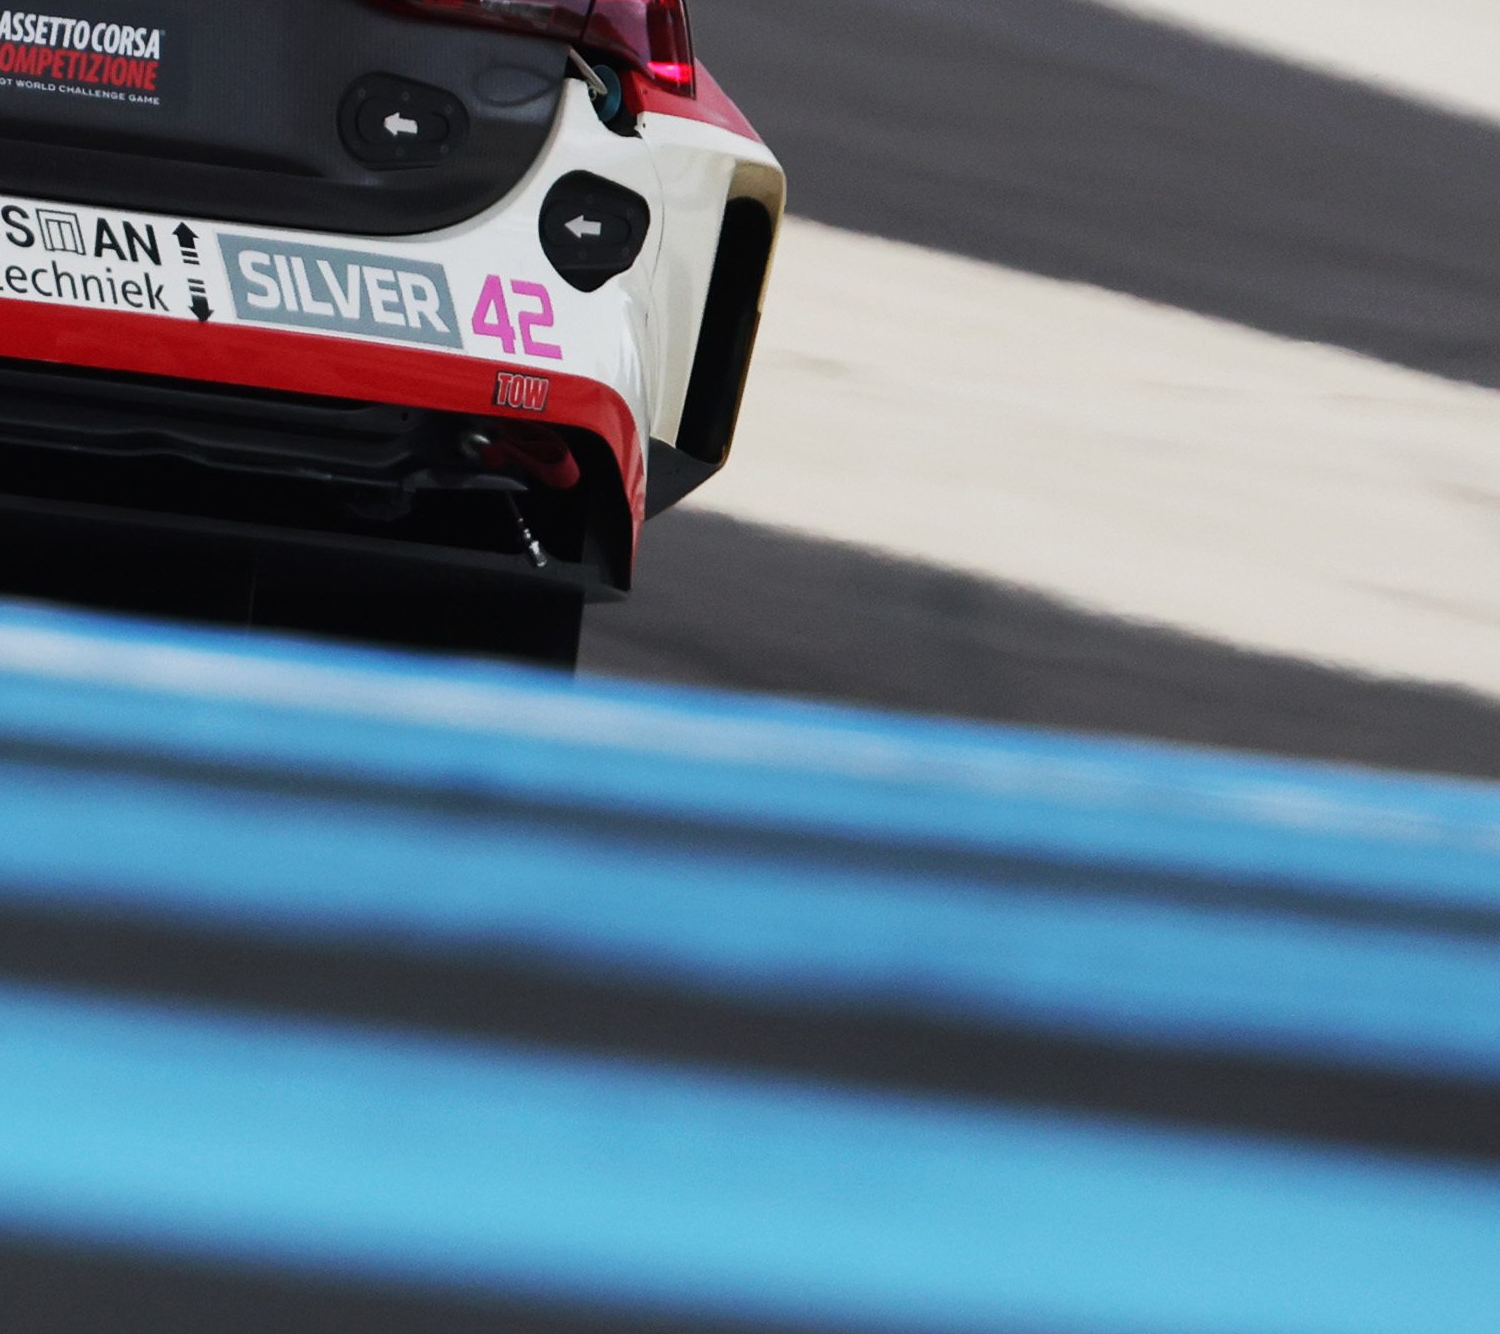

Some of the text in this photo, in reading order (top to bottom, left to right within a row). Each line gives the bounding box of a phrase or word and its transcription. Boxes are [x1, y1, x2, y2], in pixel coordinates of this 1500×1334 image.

[91, 22, 160, 59] CORSA
[16, 79, 56, 92] WORLD
[58, 84, 126, 101] CHALLENGE
[128, 93, 160, 105] GAME
[237, 249, 452, 334] SILVER
[471, 273, 563, 361] 42
[496, 373, 550, 411] TOW
